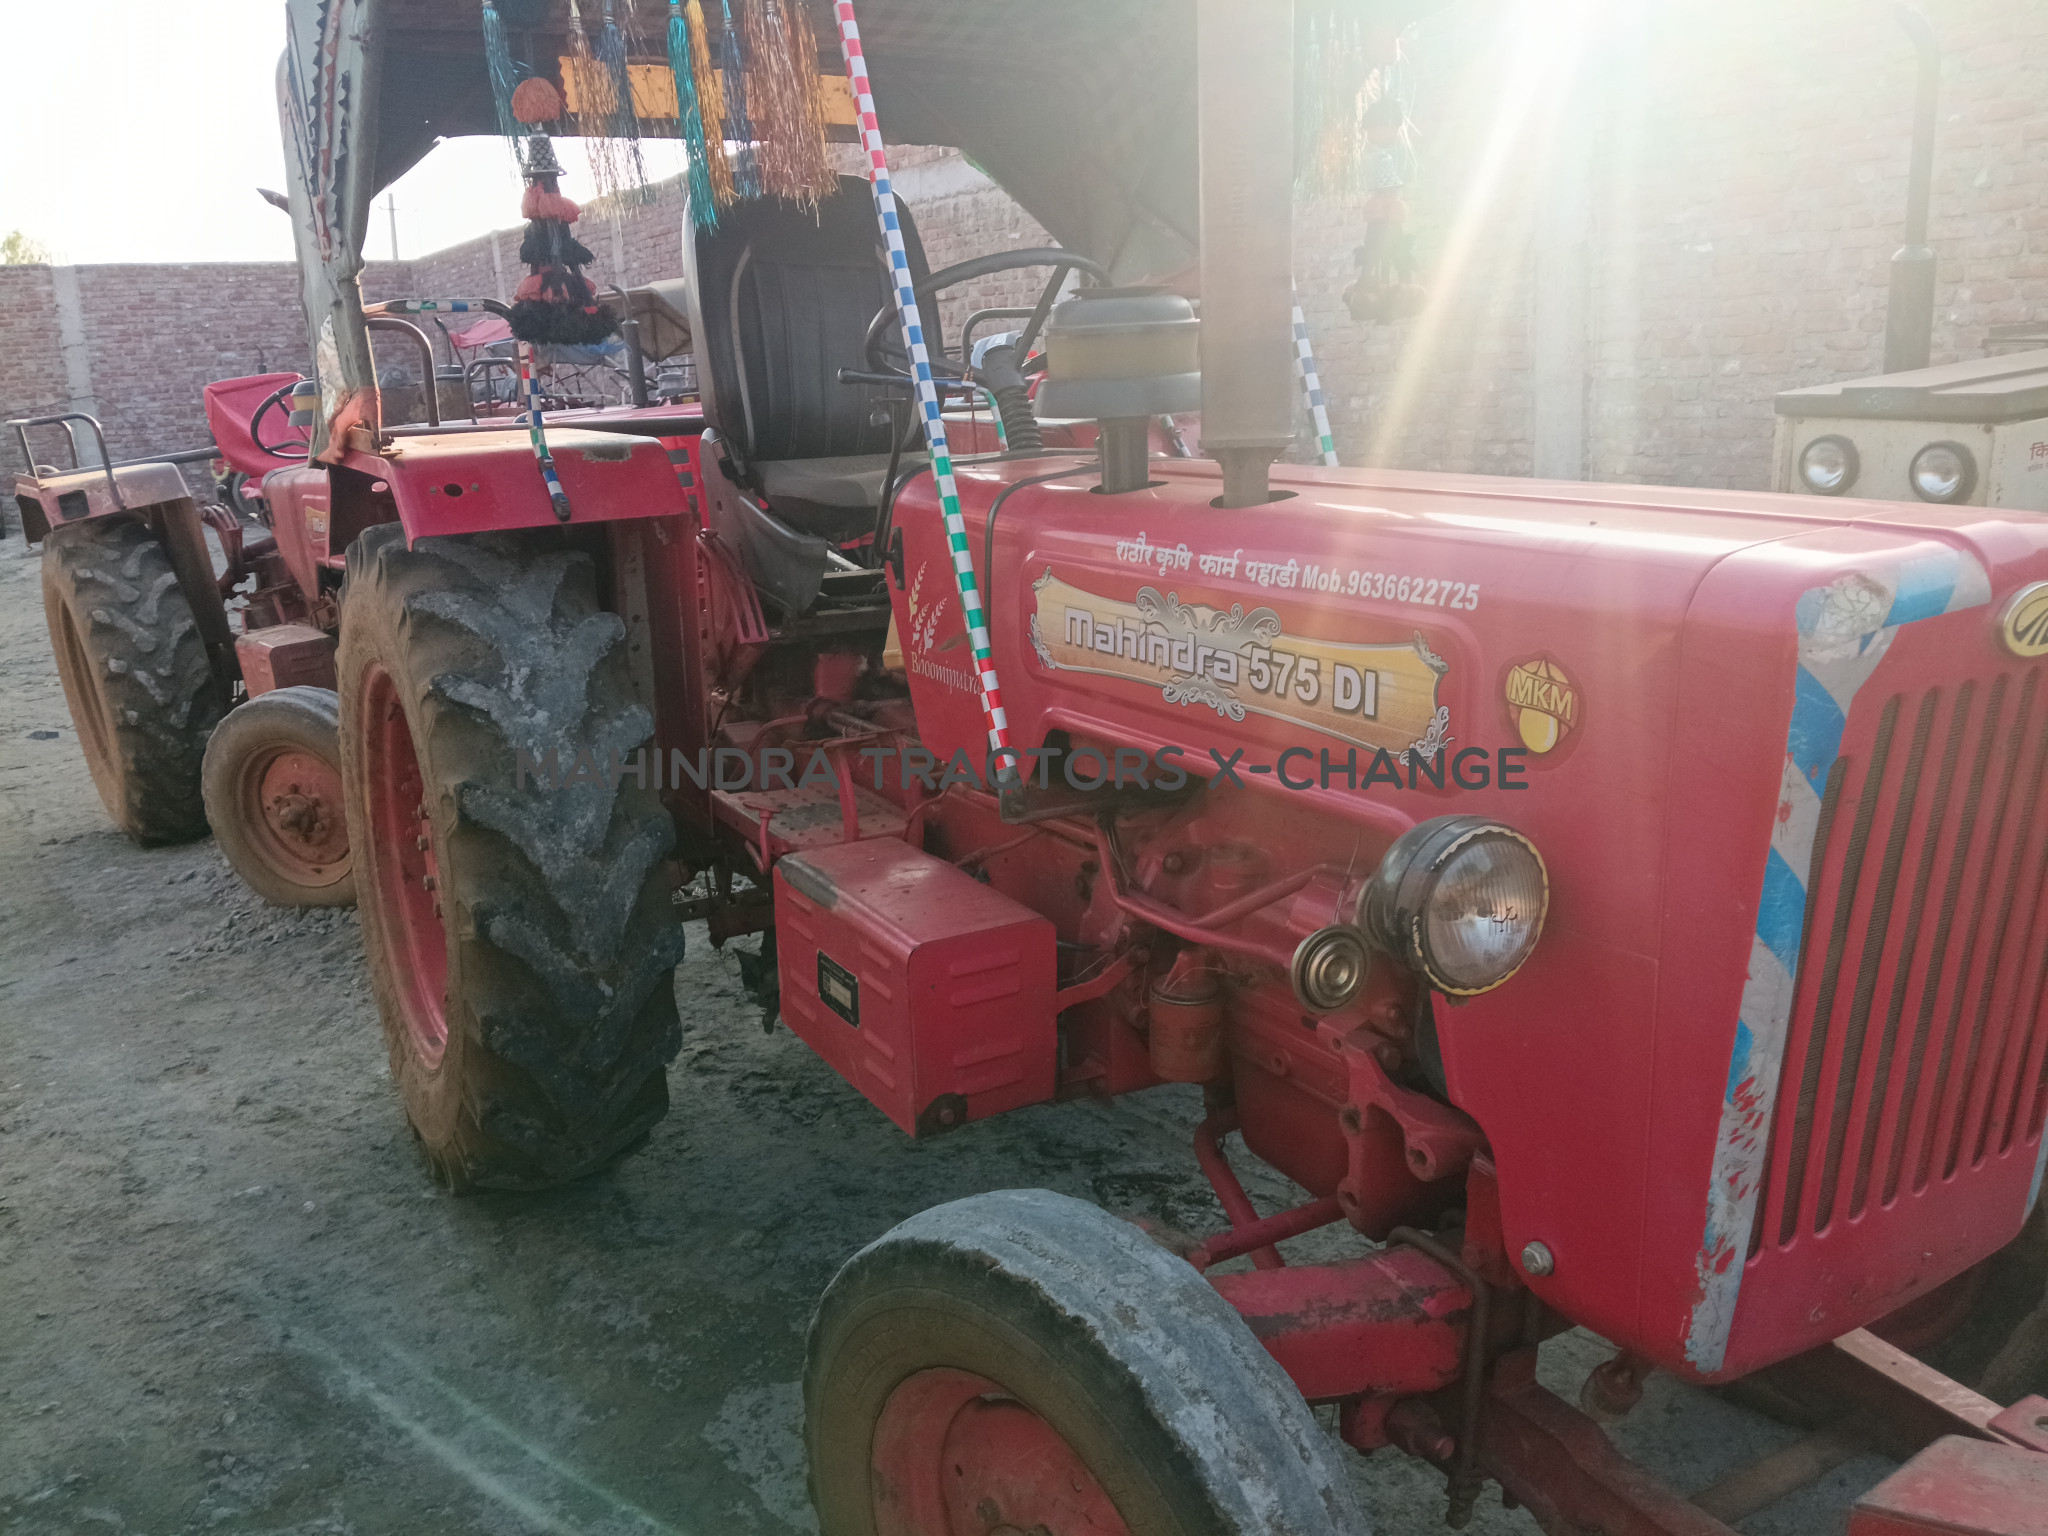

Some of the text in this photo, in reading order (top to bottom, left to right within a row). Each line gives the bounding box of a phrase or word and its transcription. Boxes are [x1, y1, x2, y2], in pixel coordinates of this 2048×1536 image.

[1116, 531, 1154, 565] राठौर
[1156, 543, 1193, 577] कृषि
[1301, 564, 1480, 611] Mob.9636622725
[1064, 606, 1378, 717] Mahindra 575 DI
[1509, 667, 1574, 722] MKM
